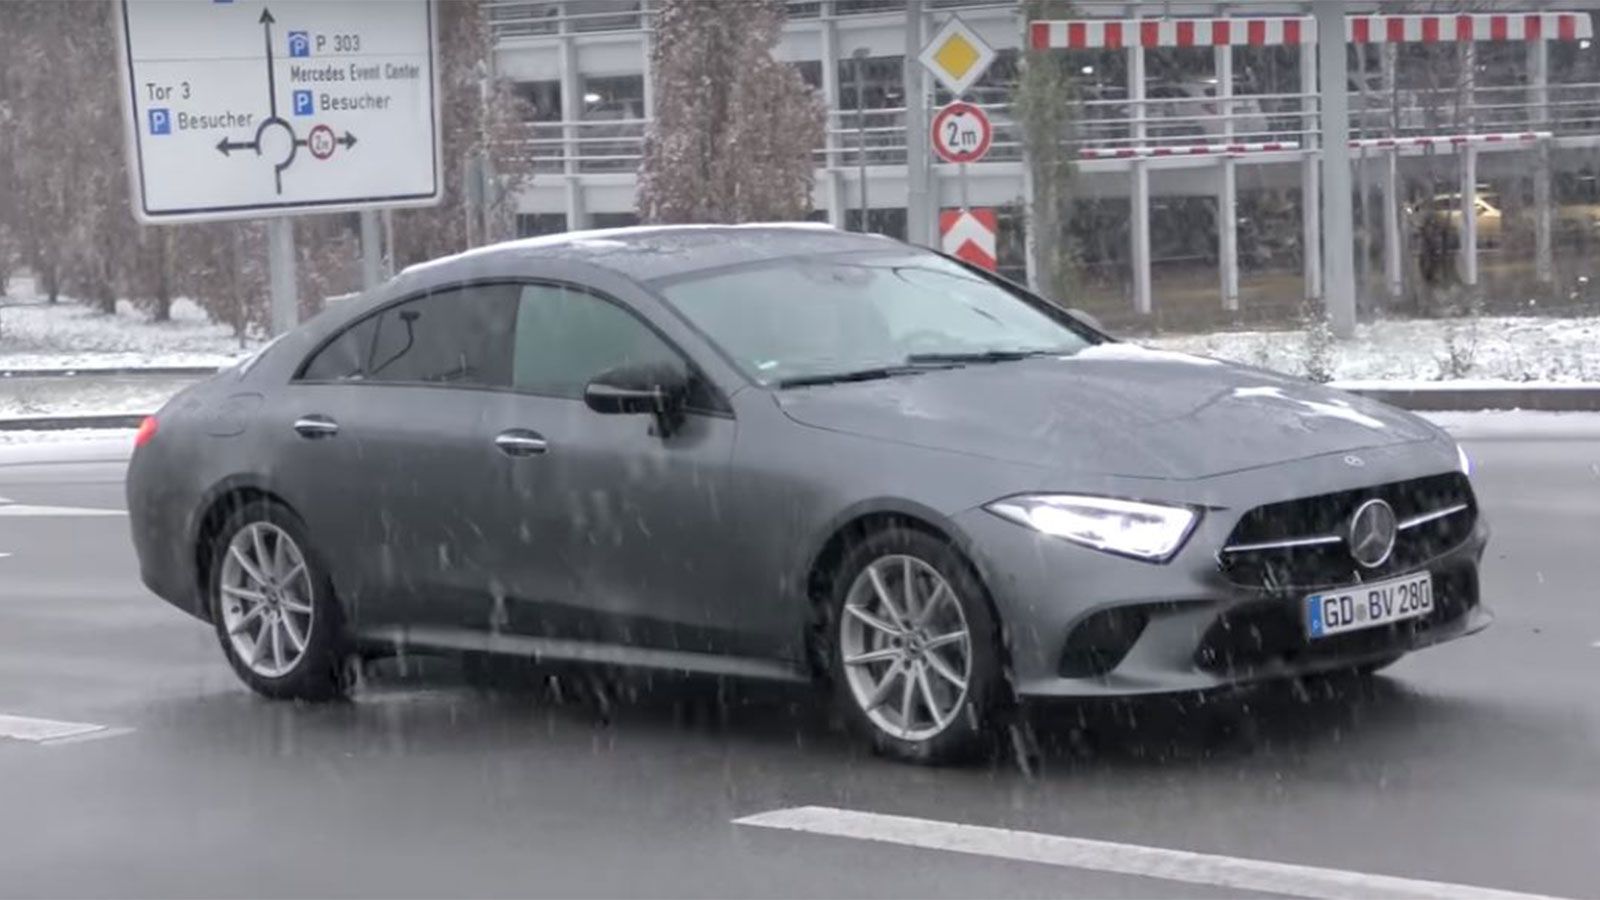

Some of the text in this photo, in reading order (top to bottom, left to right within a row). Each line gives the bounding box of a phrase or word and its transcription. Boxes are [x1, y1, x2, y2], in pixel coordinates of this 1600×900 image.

[316, 35, 325, 51] P
[334, 34, 360, 52] 303
[290, 62, 420, 81] Mercedes Event Center
[146, 81, 190, 100] Tor 3
[320, 92, 390, 110] Besucher
[152, 111, 253, 132] P Besucher
[1323, 579, 1430, 628] GD BV 280
